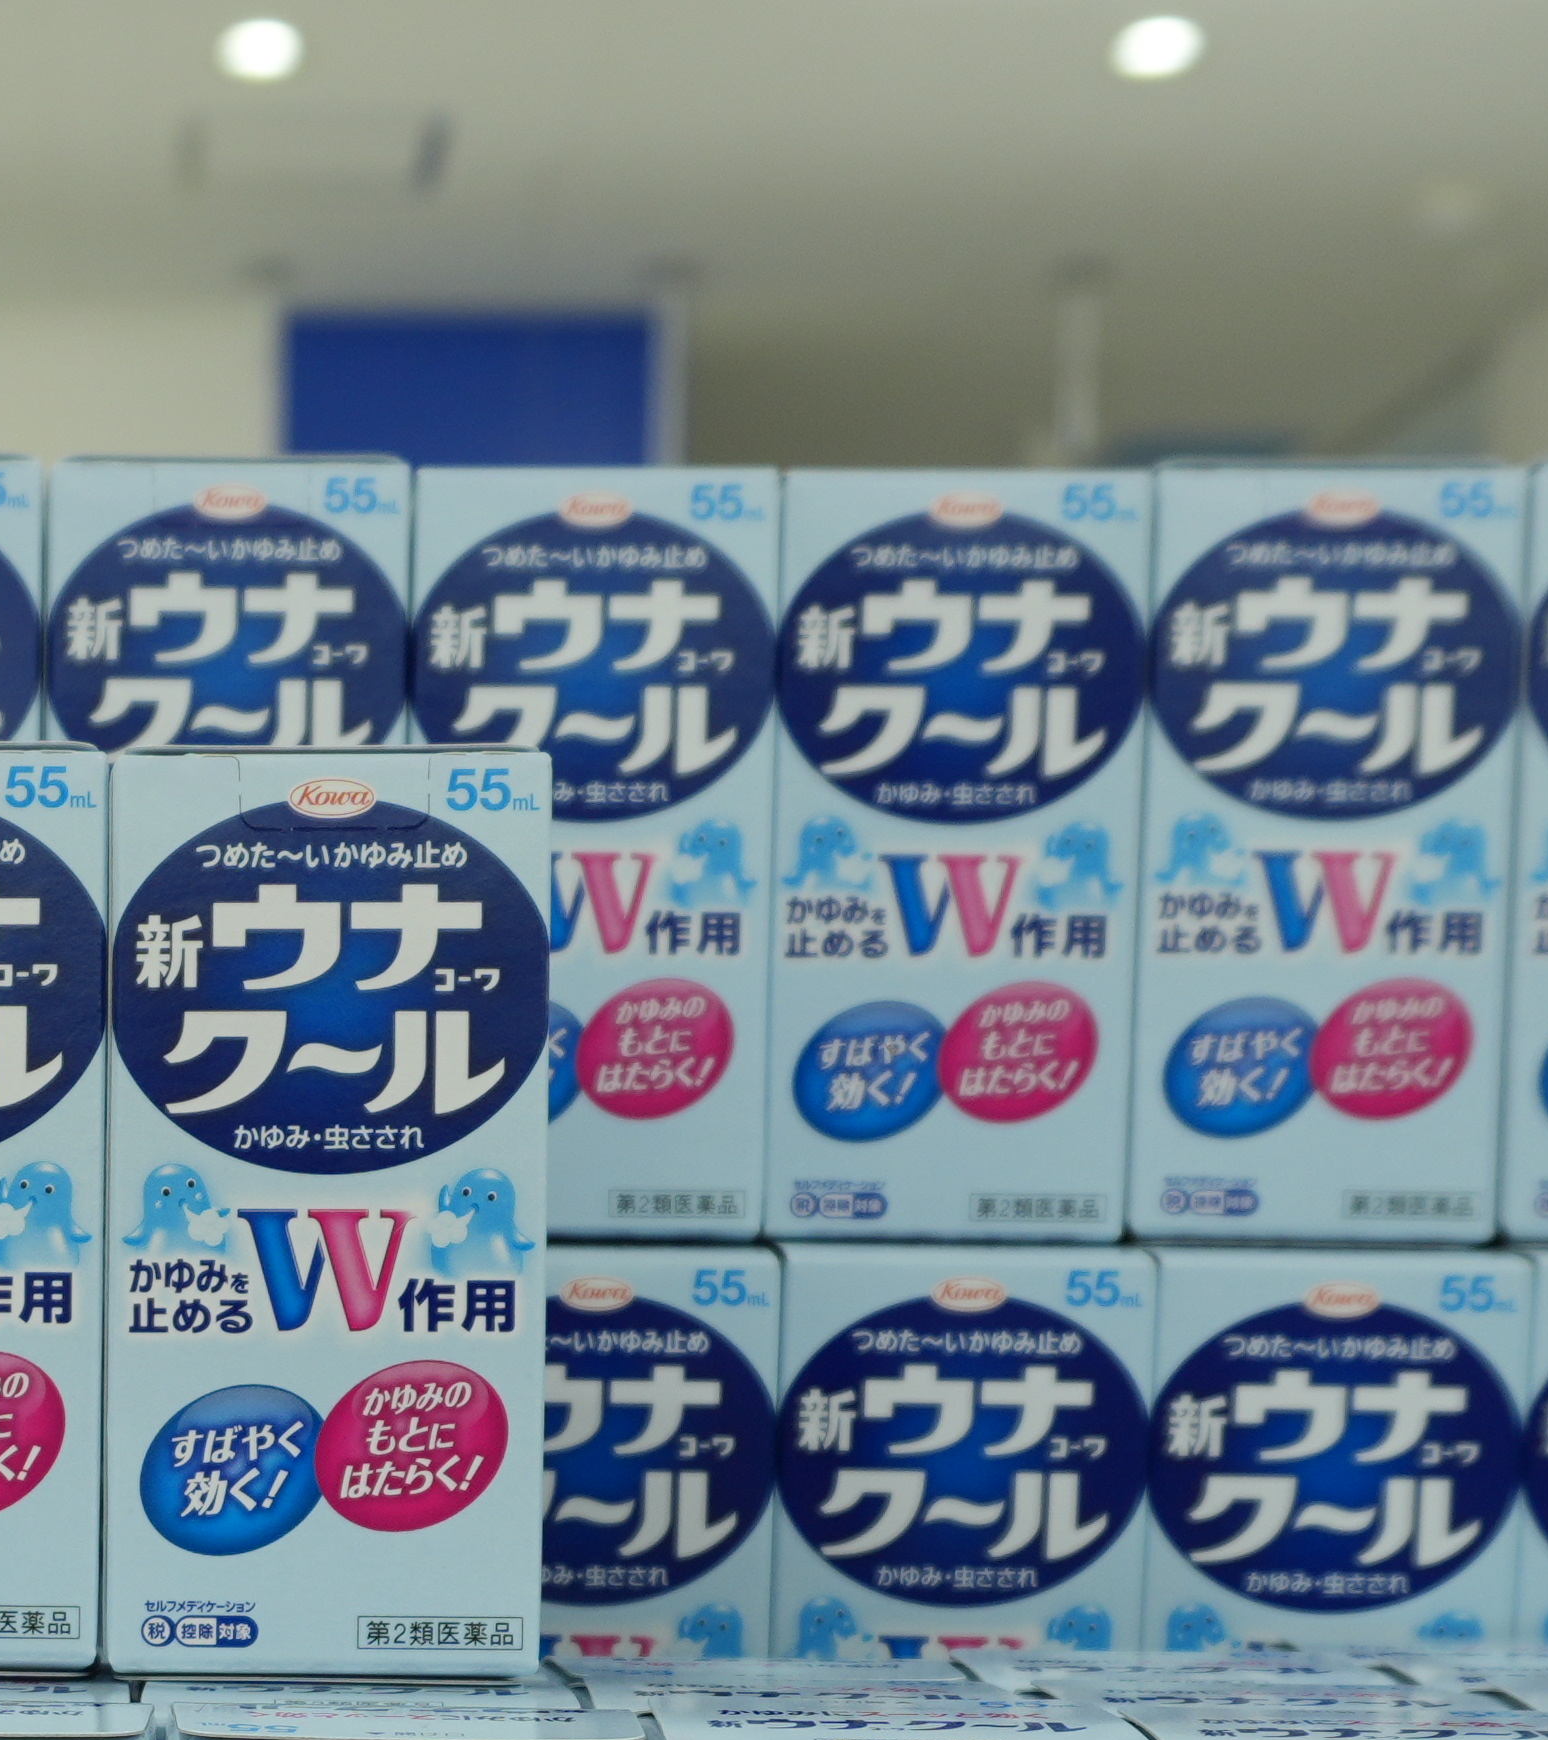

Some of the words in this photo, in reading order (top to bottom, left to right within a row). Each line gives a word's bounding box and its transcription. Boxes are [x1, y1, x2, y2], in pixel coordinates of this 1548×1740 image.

[294, 782, 373, 807] Kowa
[446, 769, 540, 811] 55mL
[363, 1381, 471, 1416] かゆみの
[171, 1421, 305, 1468] すばやく
[365, 1417, 456, 1454] もとに
[366, 1621, 514, 1646] 第2類医薬品
